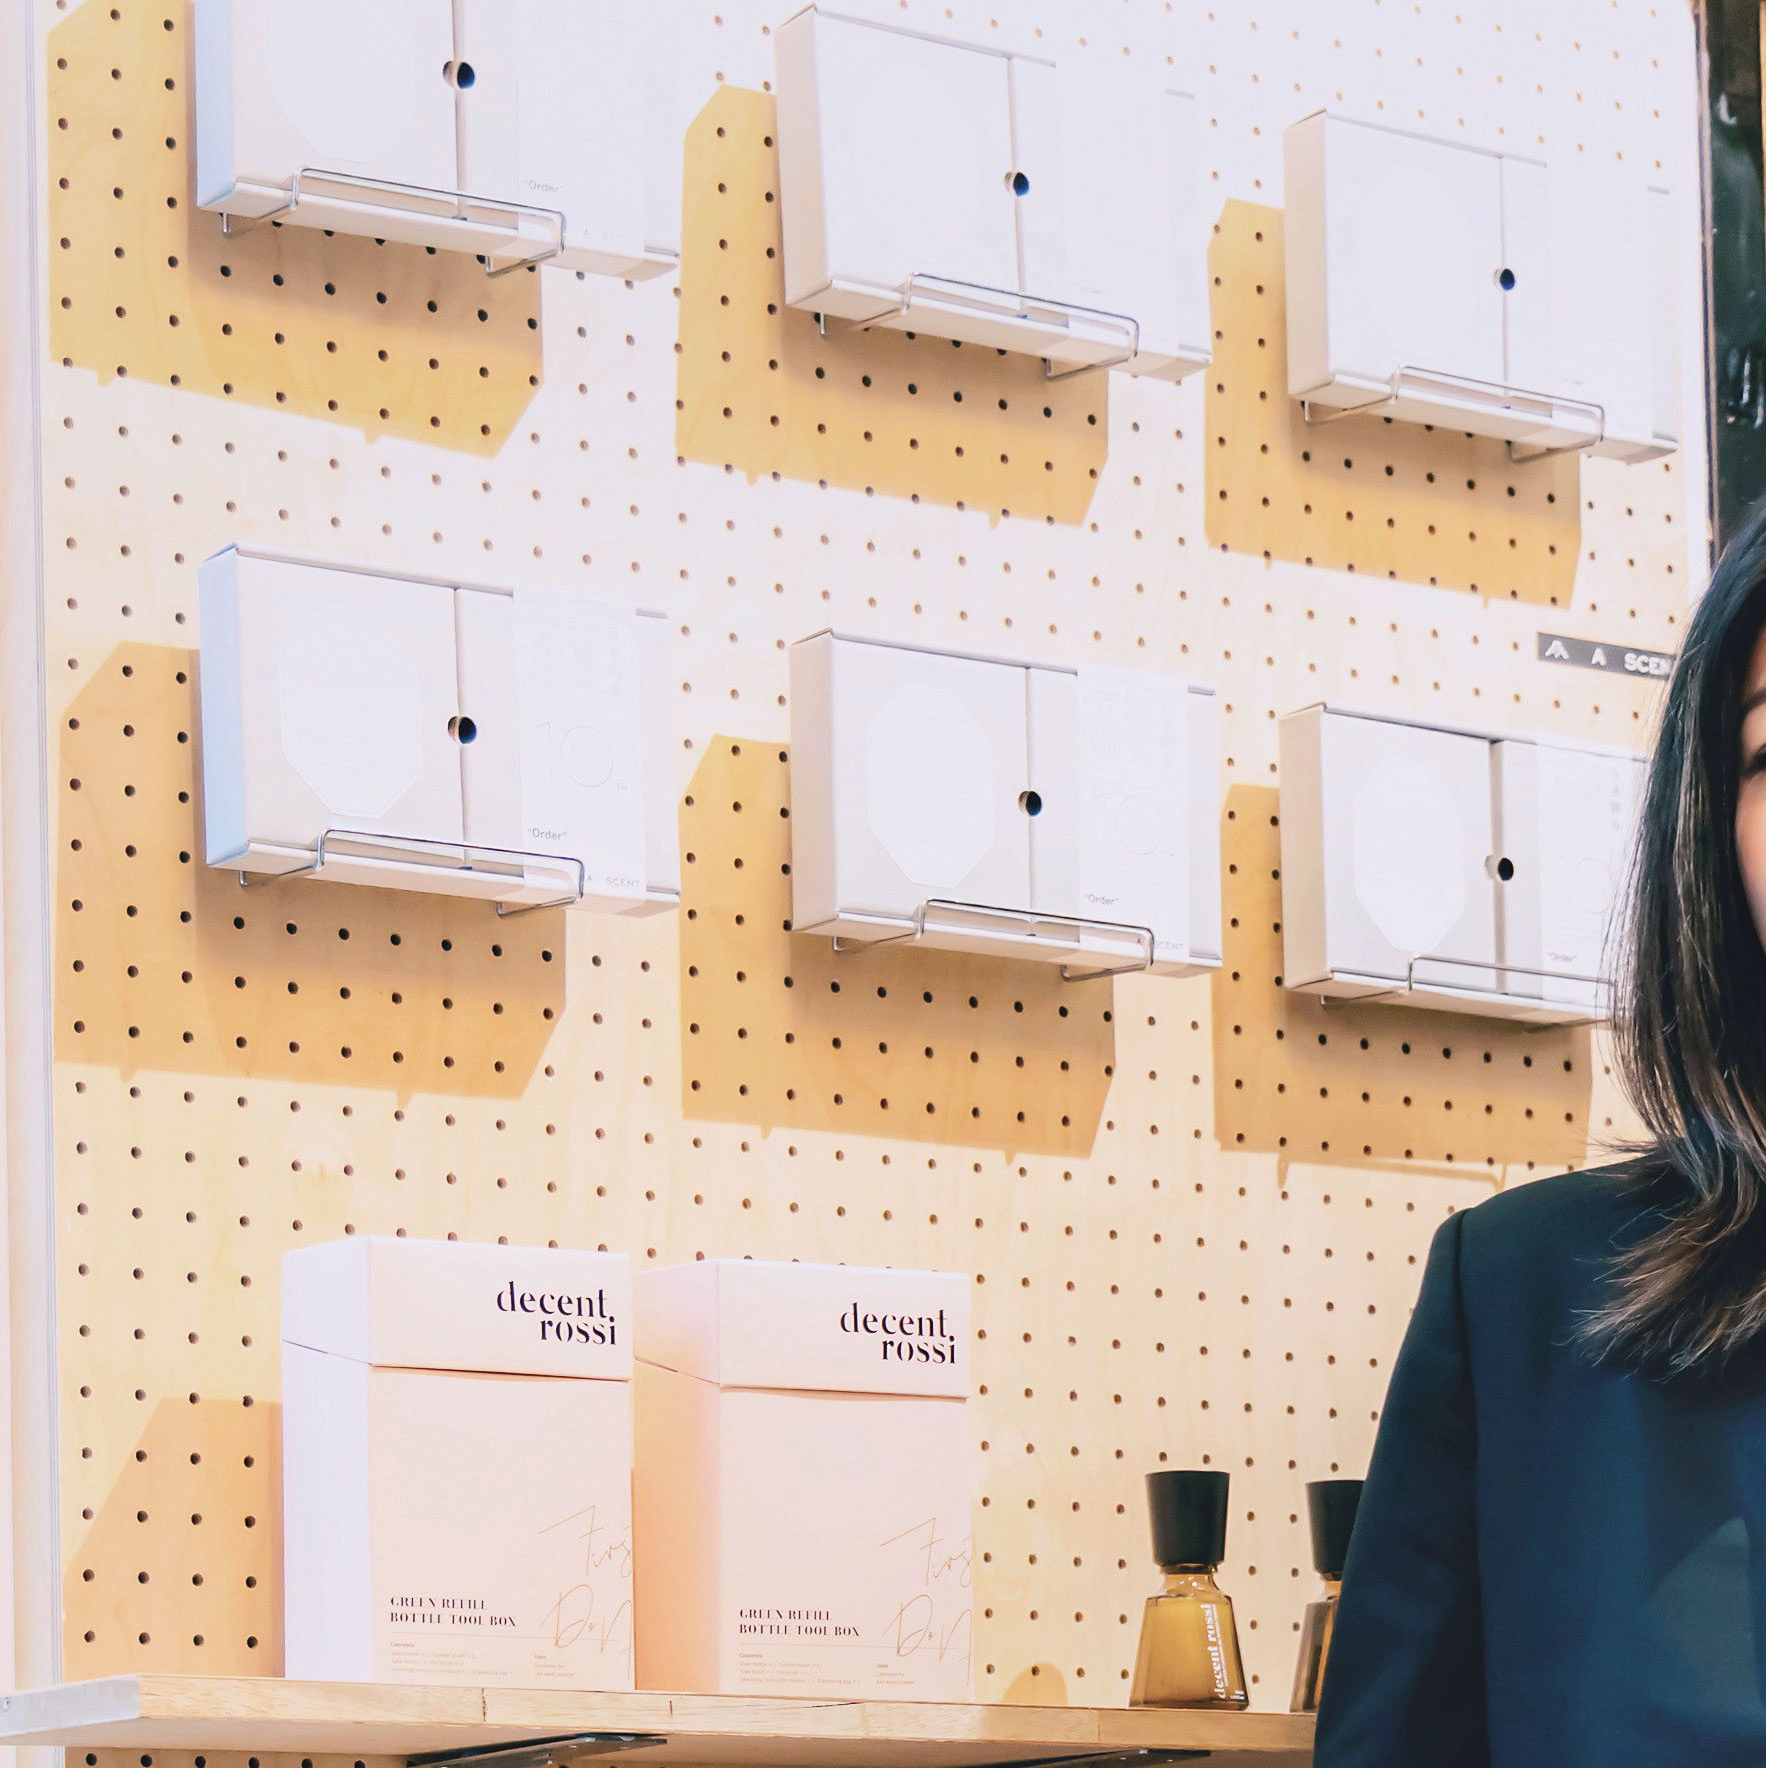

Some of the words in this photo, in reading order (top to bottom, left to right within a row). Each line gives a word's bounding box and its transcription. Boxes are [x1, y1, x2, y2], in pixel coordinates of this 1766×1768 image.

[1624, 652, 1672, 676] SCEN
[496, 1280, 608, 1319] decent
[539, 1316, 617, 1346] rossi
[839, 1302, 949, 1338] decent
[880, 1335, 957, 1365] rossi
[390, 1596, 437, 1608] GREEN
[442, 1598, 489, 1611] REFILL
[739, 1608, 784, 1619] GREEN
[789, 1610, 833, 1621] REFILL
[390, 1612, 445, 1624] BOTTLE
[450, 1613, 486, 1626] TOOL
[490, 1615, 517, 1628] BOX
[739, 1624, 791, 1635] BOTTLE
[795, 1625, 830, 1636] TOOL
[834, 1626, 861, 1637] BOX
[1199, 1603, 1217, 1642] rossi
[1206, 1646, 1226, 1699] decent
